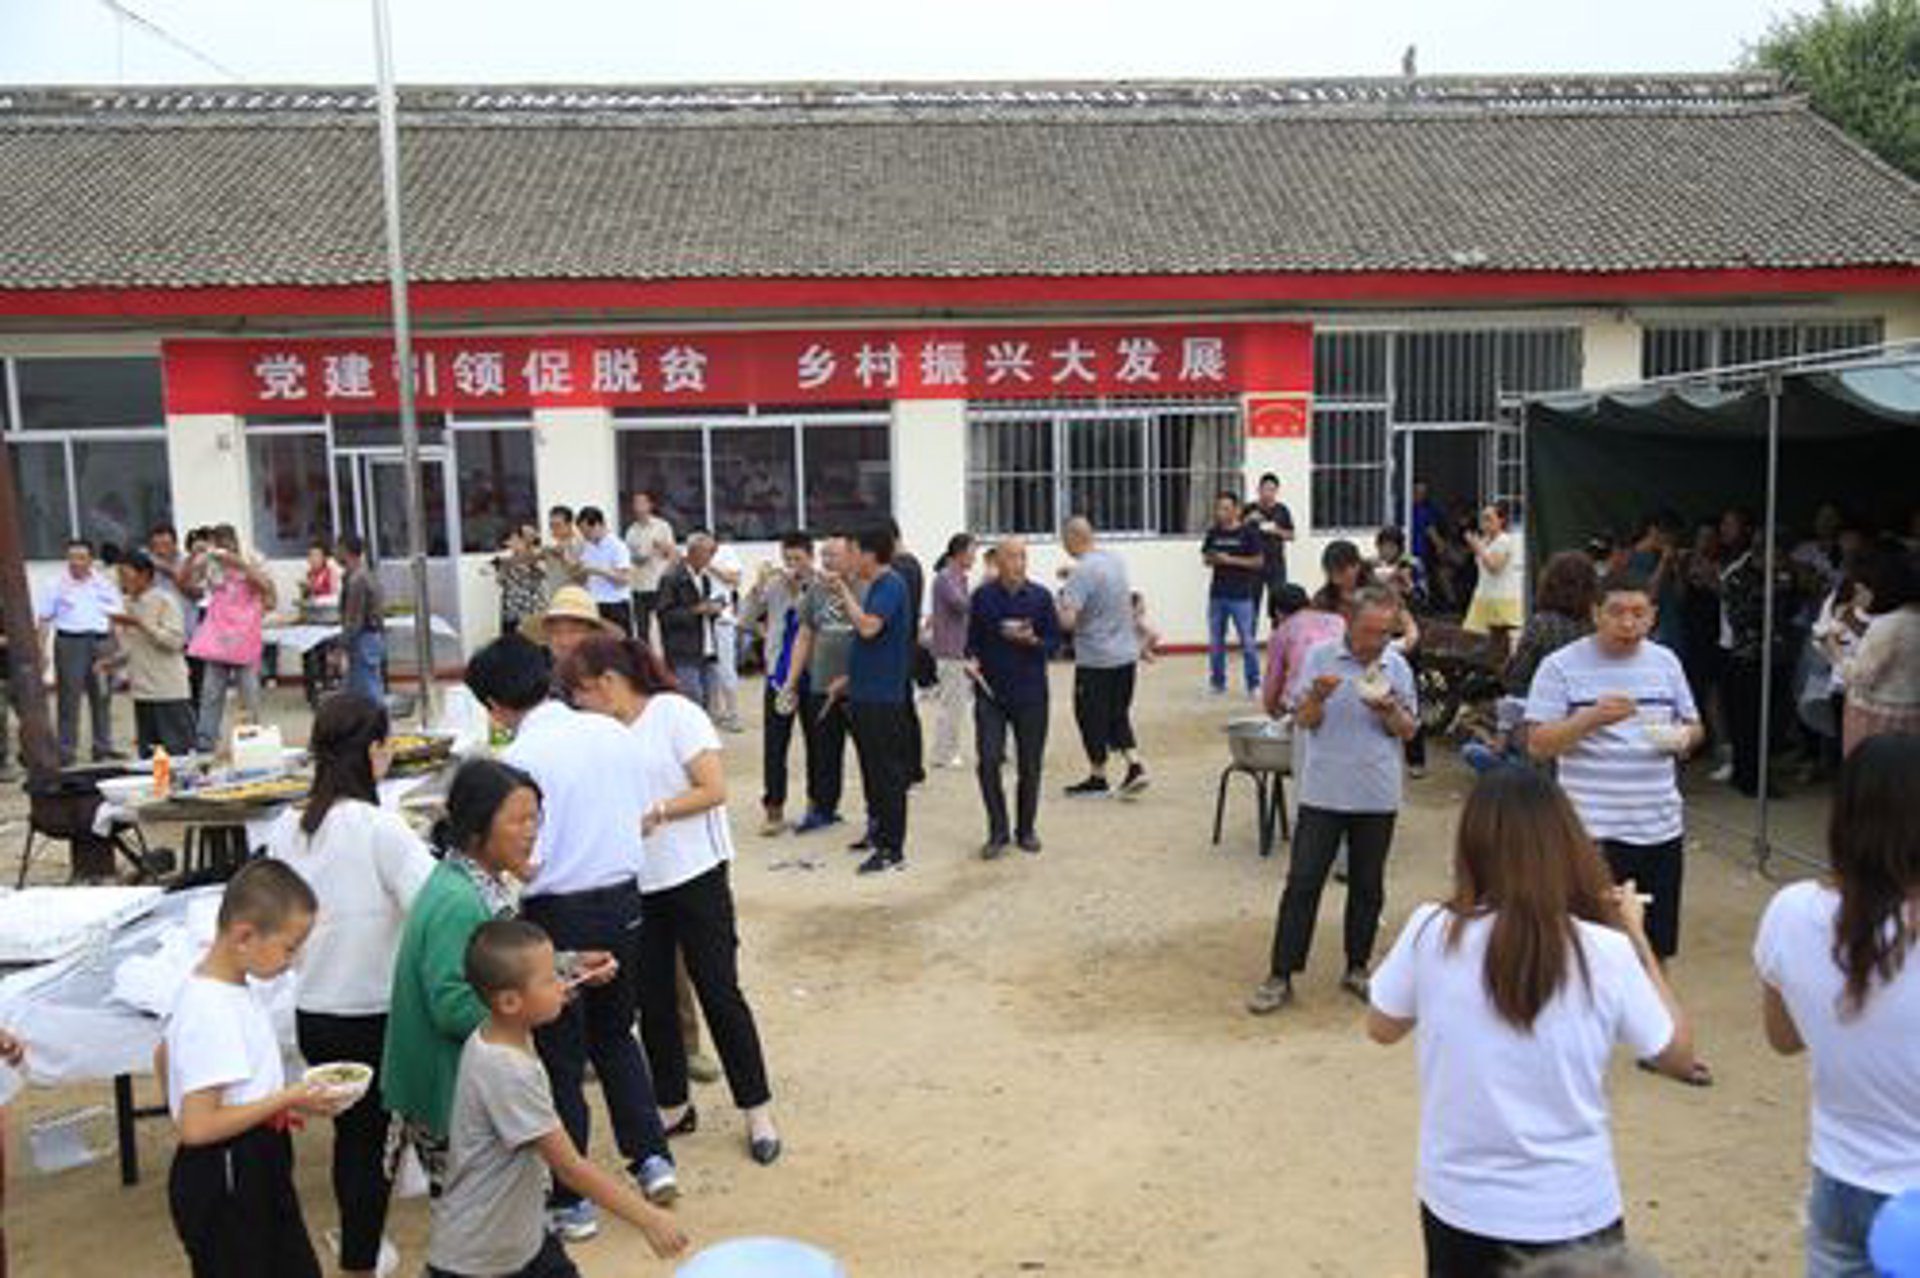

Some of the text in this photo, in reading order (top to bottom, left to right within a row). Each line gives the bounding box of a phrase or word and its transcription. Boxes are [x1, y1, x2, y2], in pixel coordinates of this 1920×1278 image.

[255, 337, 1227, 400] 党建引领促脱贫 乡村振兴大发展
